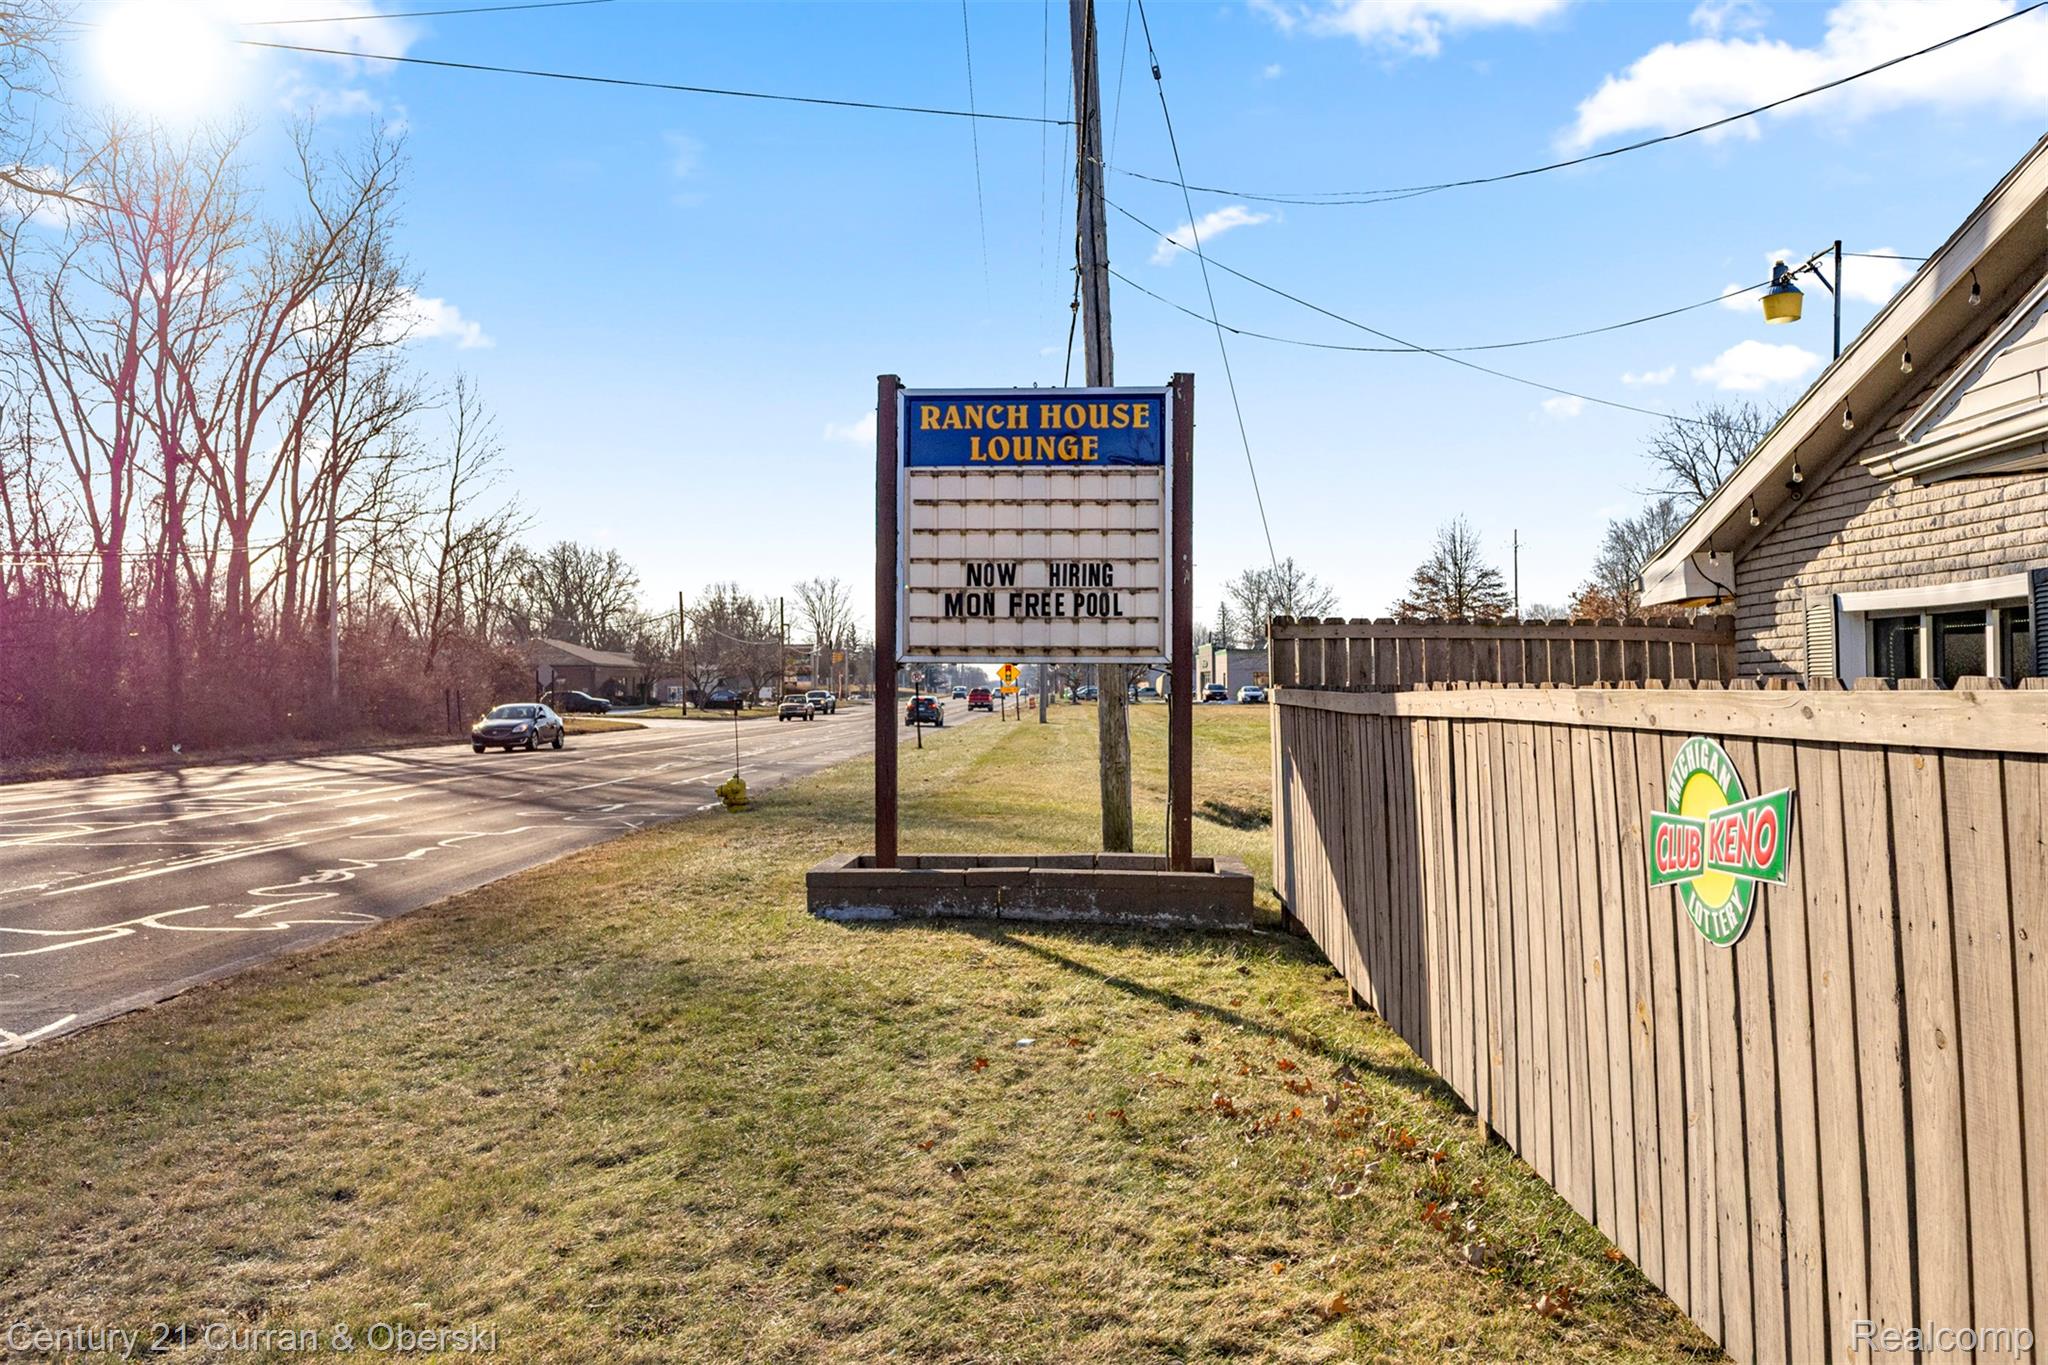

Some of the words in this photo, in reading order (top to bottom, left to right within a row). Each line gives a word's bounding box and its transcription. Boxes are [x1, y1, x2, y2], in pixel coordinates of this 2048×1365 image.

[920, 404, 1029, 430] RANCH
[1039, 403, 1150, 429] HOUSE
[970, 435, 1099, 461] LOUNGE
[966, 562, 1017, 587] NOW
[1049, 562, 1114, 587] HIRING
[944, 592, 995, 617] MON
[1009, 592, 1065, 617] FREE
[1073, 592, 1123, 617] POOL
[1668, 742, 1731, 809] MICHIGAN
[1656, 822, 1702, 875] CLUB
[1708, 805, 1778, 870] KENO
[1688, 885, 1745, 938] LOTTERY
